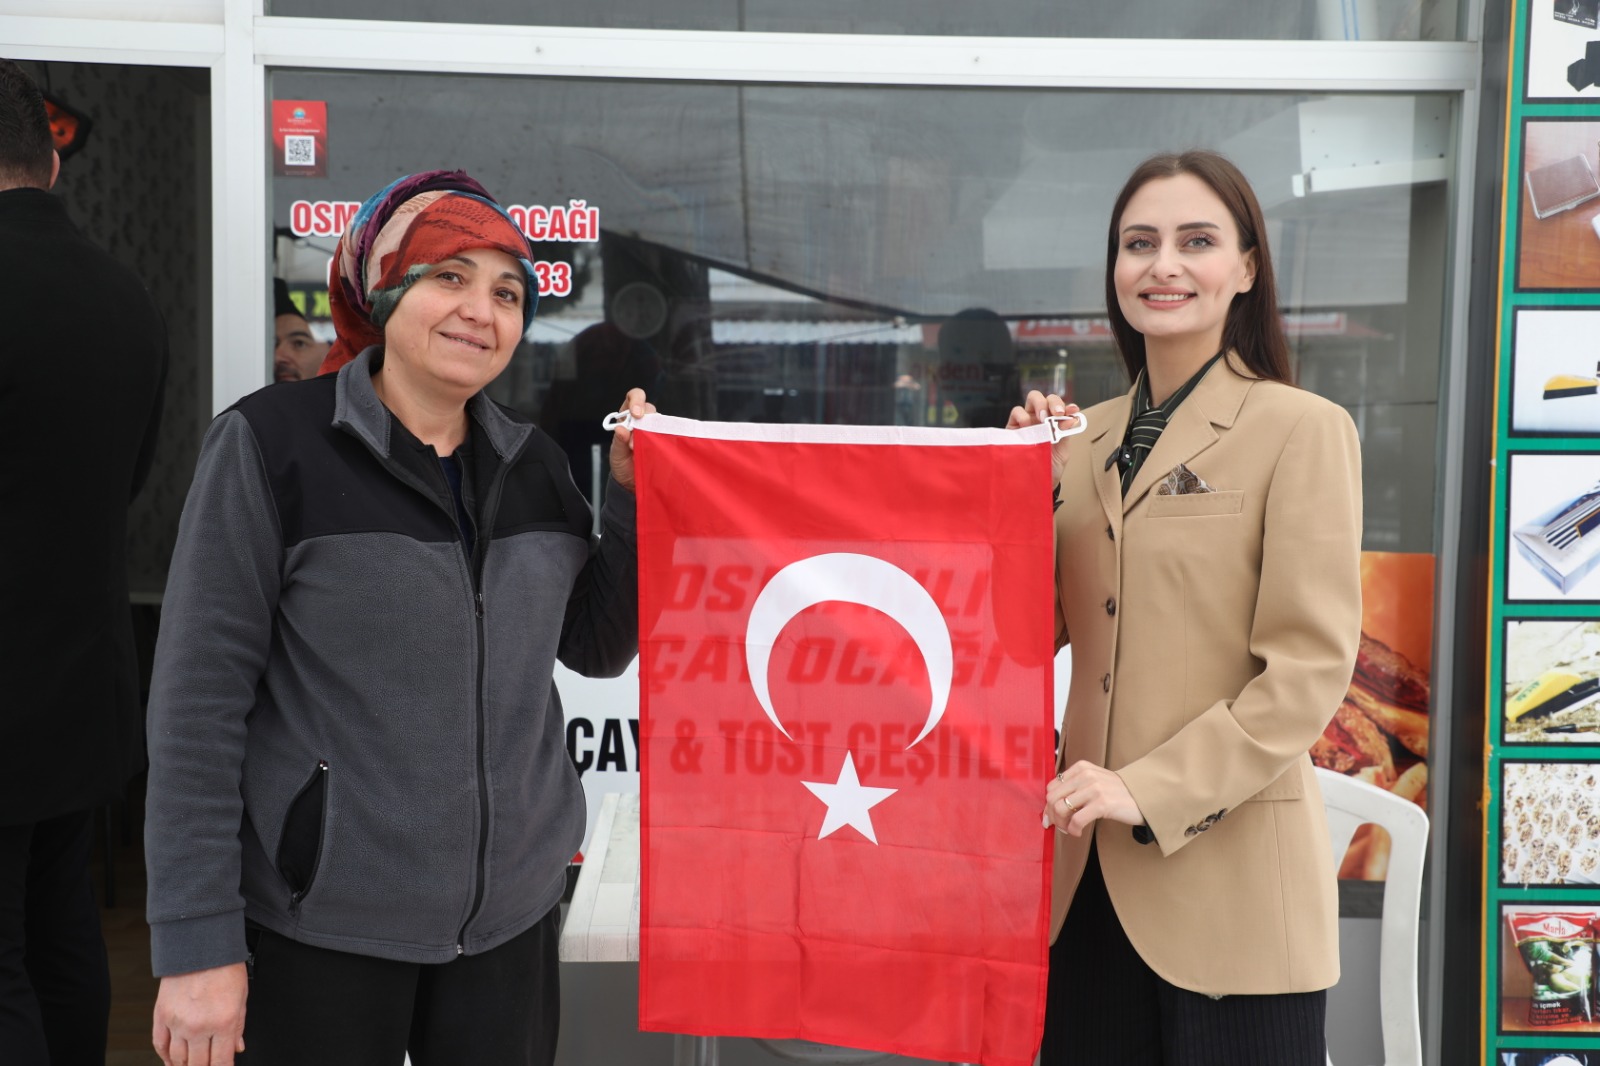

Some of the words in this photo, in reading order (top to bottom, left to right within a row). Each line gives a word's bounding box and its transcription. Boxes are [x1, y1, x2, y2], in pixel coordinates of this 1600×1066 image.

[291, 201, 361, 236] OSM
[507, 200, 600, 242] OCAĞI
[662, 564, 990, 617] OSLI
[787, 629, 1004, 689] OCAĞI
[566, 717, 655, 779] ÇAY
[670, 718, 703, 776] &
[718, 718, 832, 777] TOST
